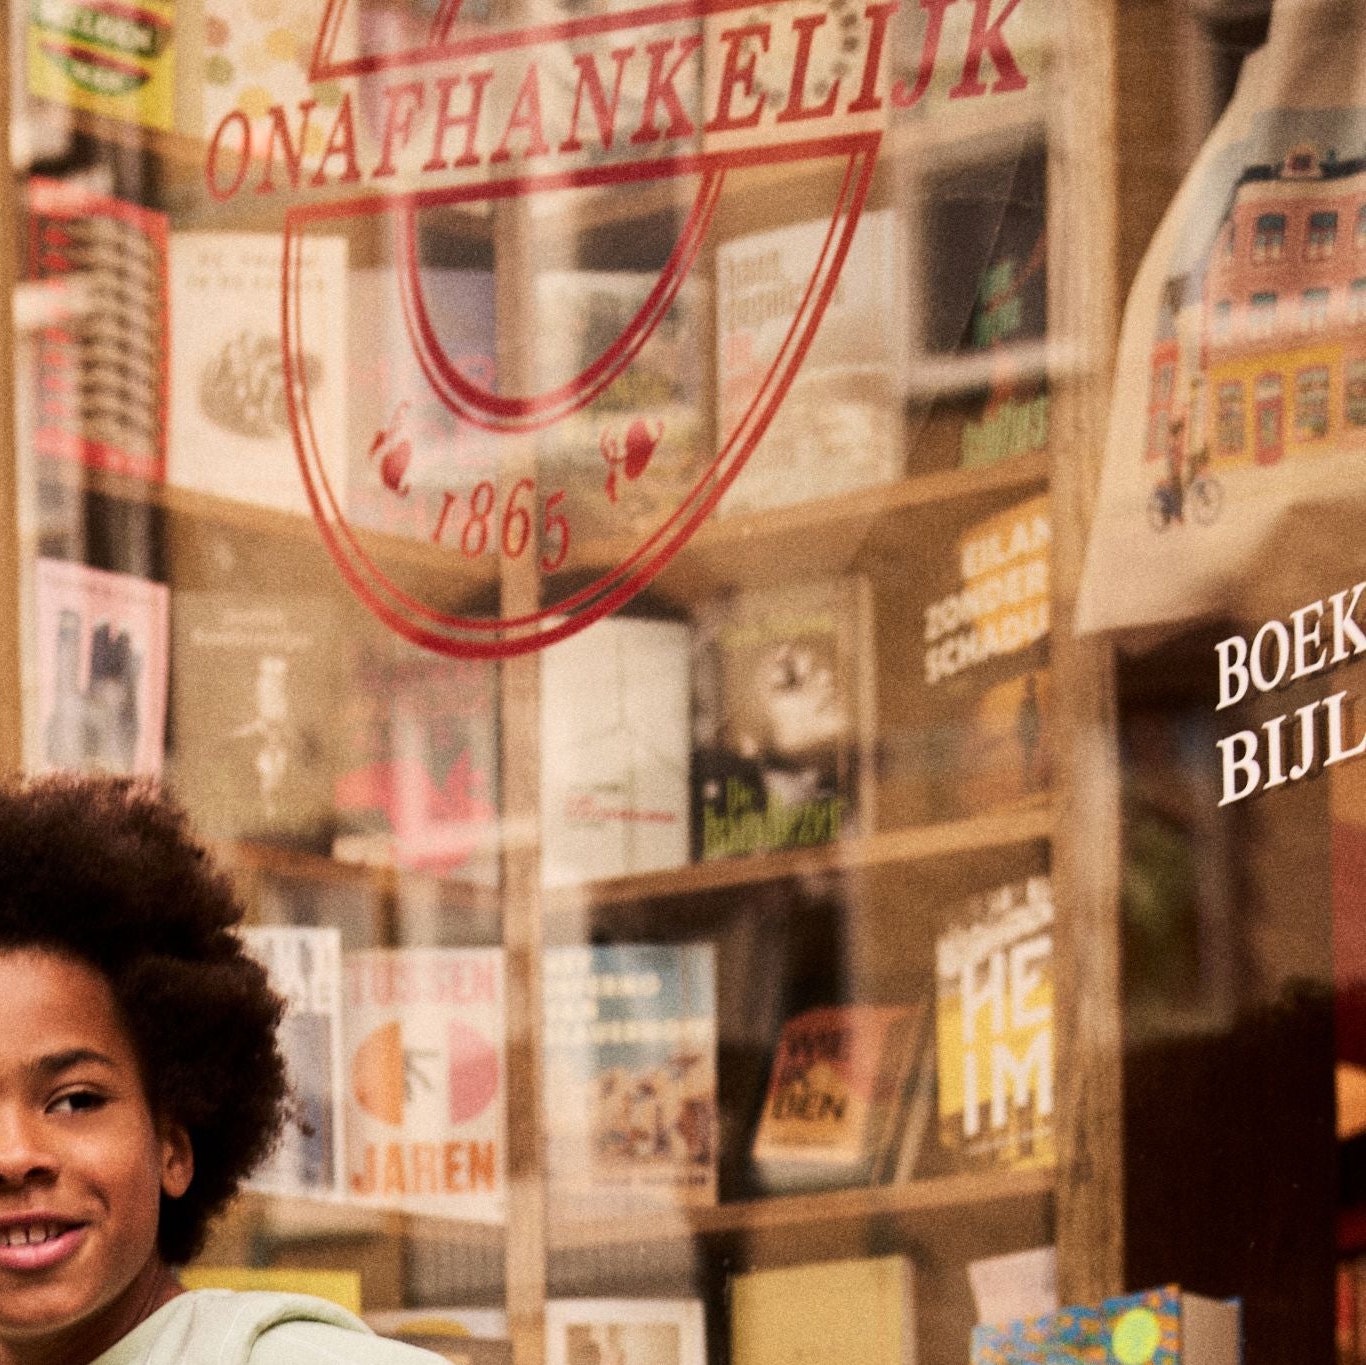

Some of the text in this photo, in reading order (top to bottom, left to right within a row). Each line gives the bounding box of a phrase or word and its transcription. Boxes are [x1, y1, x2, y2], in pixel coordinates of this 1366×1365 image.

[205, 0, 1029, 203] ONAFHANKELIJK
[432, 477, 571, 573] 1865
[1214, 580, 1366, 712] BOEK
[1215, 690, 1366, 807] BIJL
